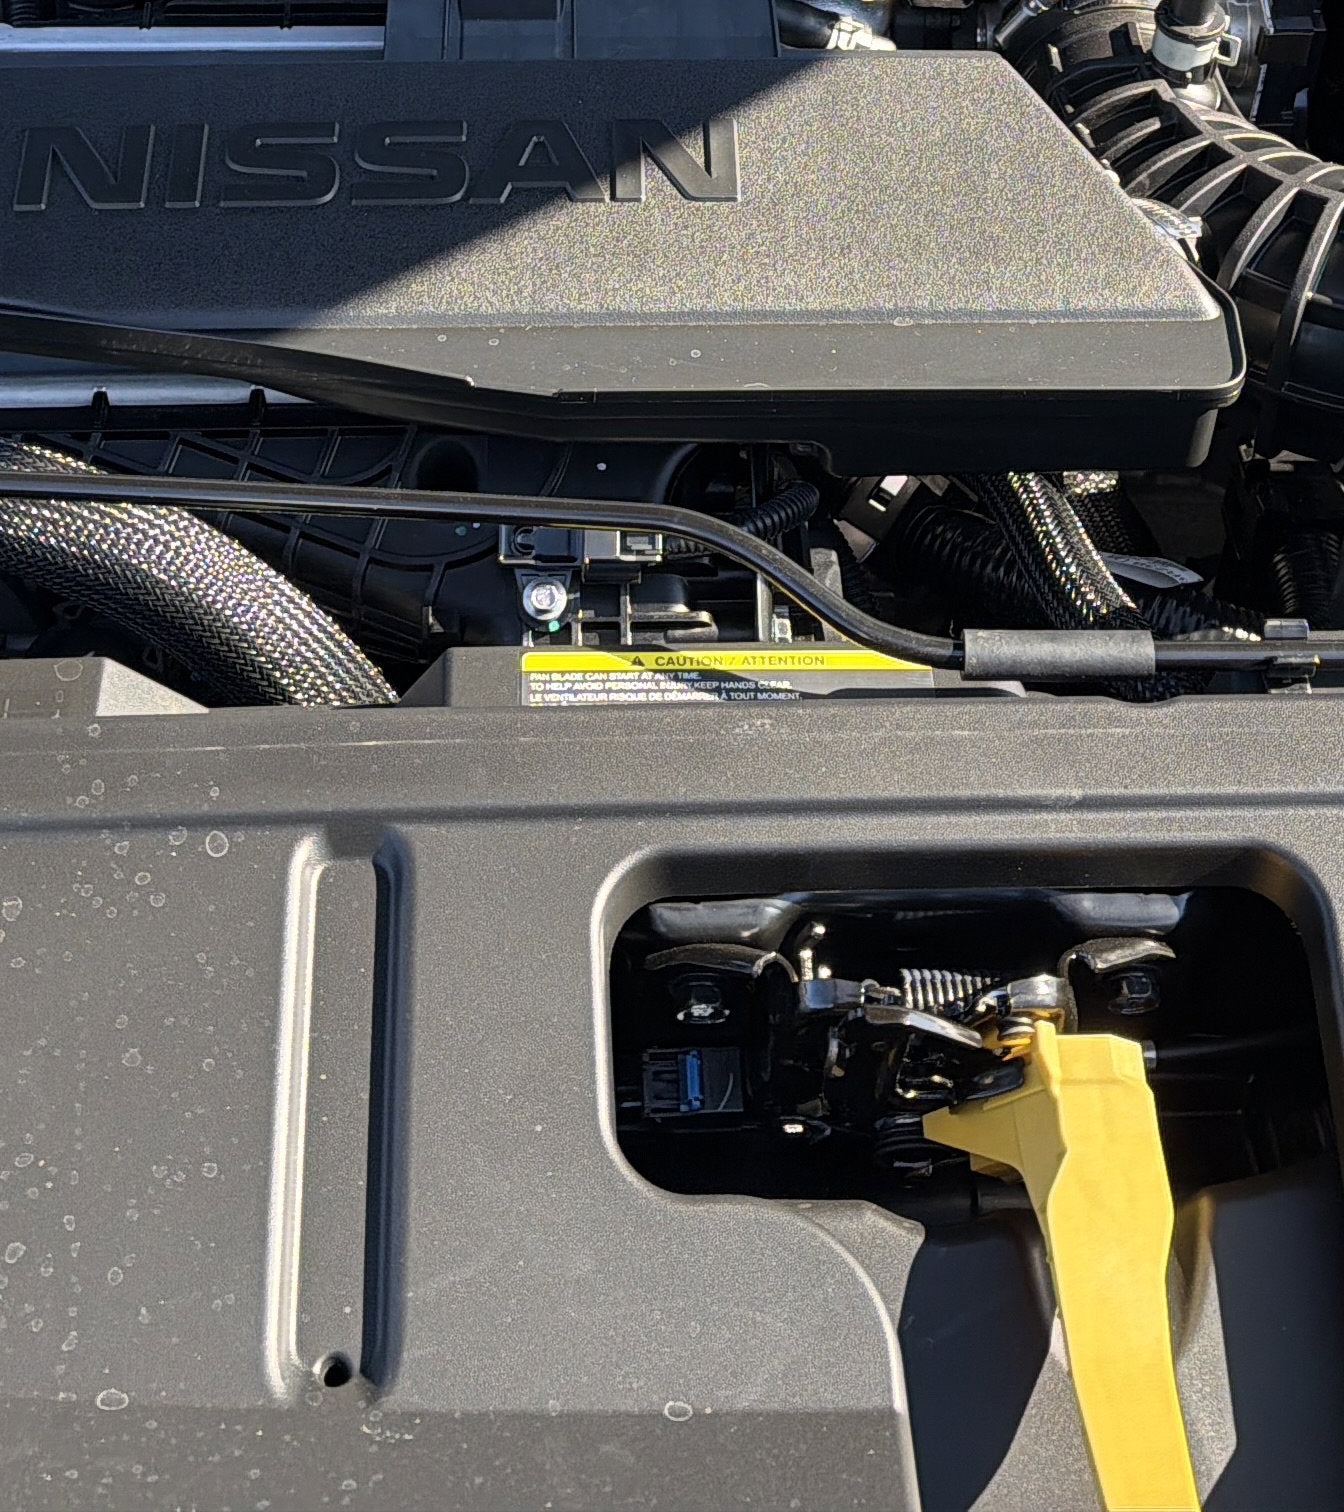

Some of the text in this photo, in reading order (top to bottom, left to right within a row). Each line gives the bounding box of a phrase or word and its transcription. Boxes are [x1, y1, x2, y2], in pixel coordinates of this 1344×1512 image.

[13, 119, 741, 211] NISSAN
[654, 655, 724, 667] CAUTION
[741, 655, 825, 666] ATTENTION
[529, 671, 702, 681] FAN BLADE CAN START AT ANY TIME.
[529, 682, 545, 691] TO
[545, 682, 573, 691] HELP
[573, 682, 604, 690] AVOID
[604, 681, 659, 690] PERSONAL
[694, 681, 719, 689] KEEP
[721, 681, 756, 689] HANDS
[529, 693, 542, 702] LE
[543, 693, 608, 702] VENTILATEUR
[608, 692, 647, 701] RISQUE
[648, 692, 663, 701] DE
[721, 690, 729, 700] À
[729, 691, 755, 700] TOUT
